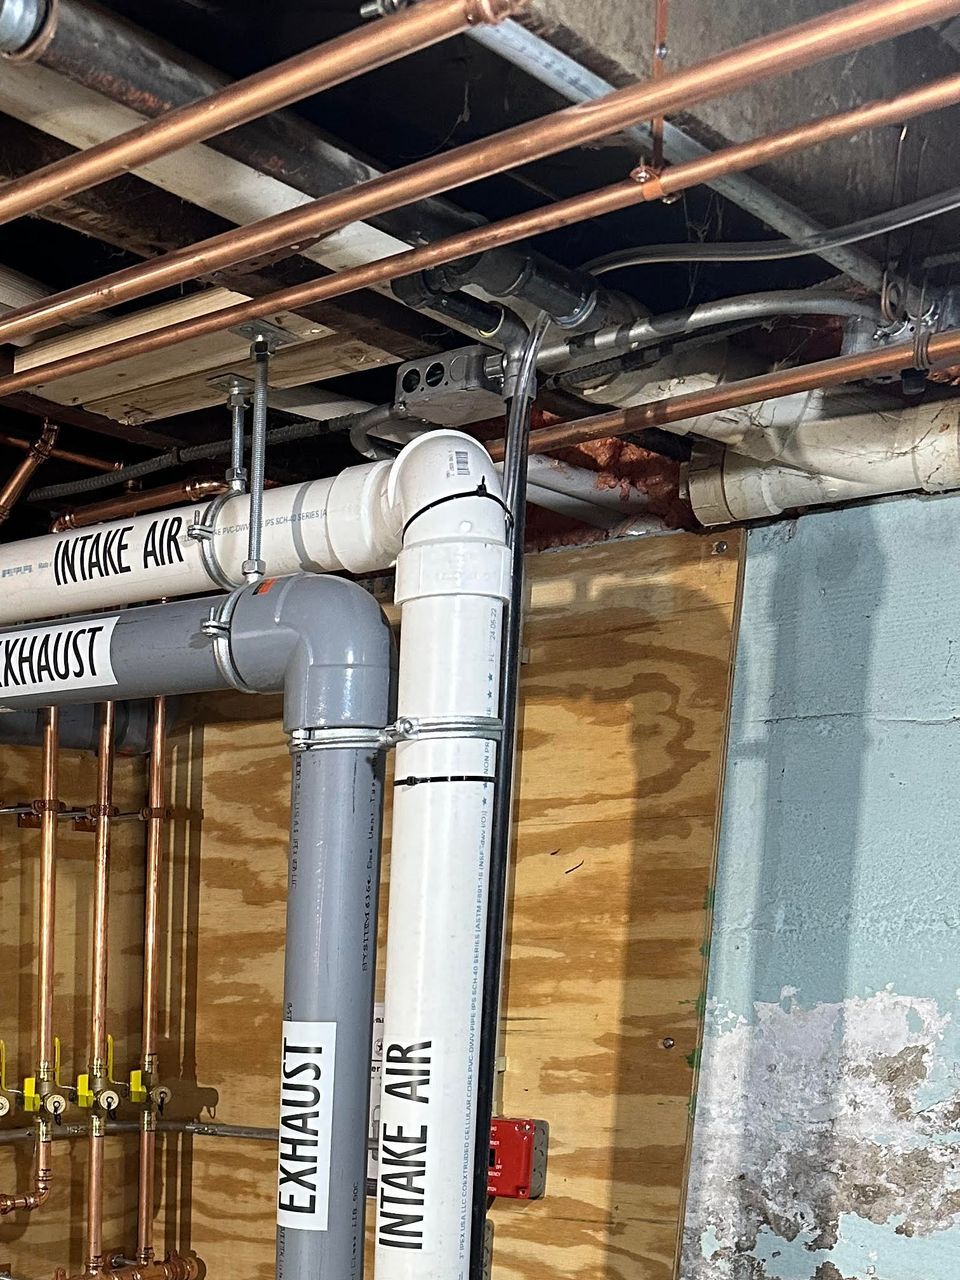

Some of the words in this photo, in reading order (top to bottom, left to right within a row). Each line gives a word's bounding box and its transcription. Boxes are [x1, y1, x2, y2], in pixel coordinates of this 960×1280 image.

[54, 525, 134, 586] INTAKE
[144, 516, 184, 569] AIR
[384, 1040, 432, 1104] AIR
[279, 1037, 322, 1214] EXHAUST
[378, 1123, 428, 1250] INTAKE
